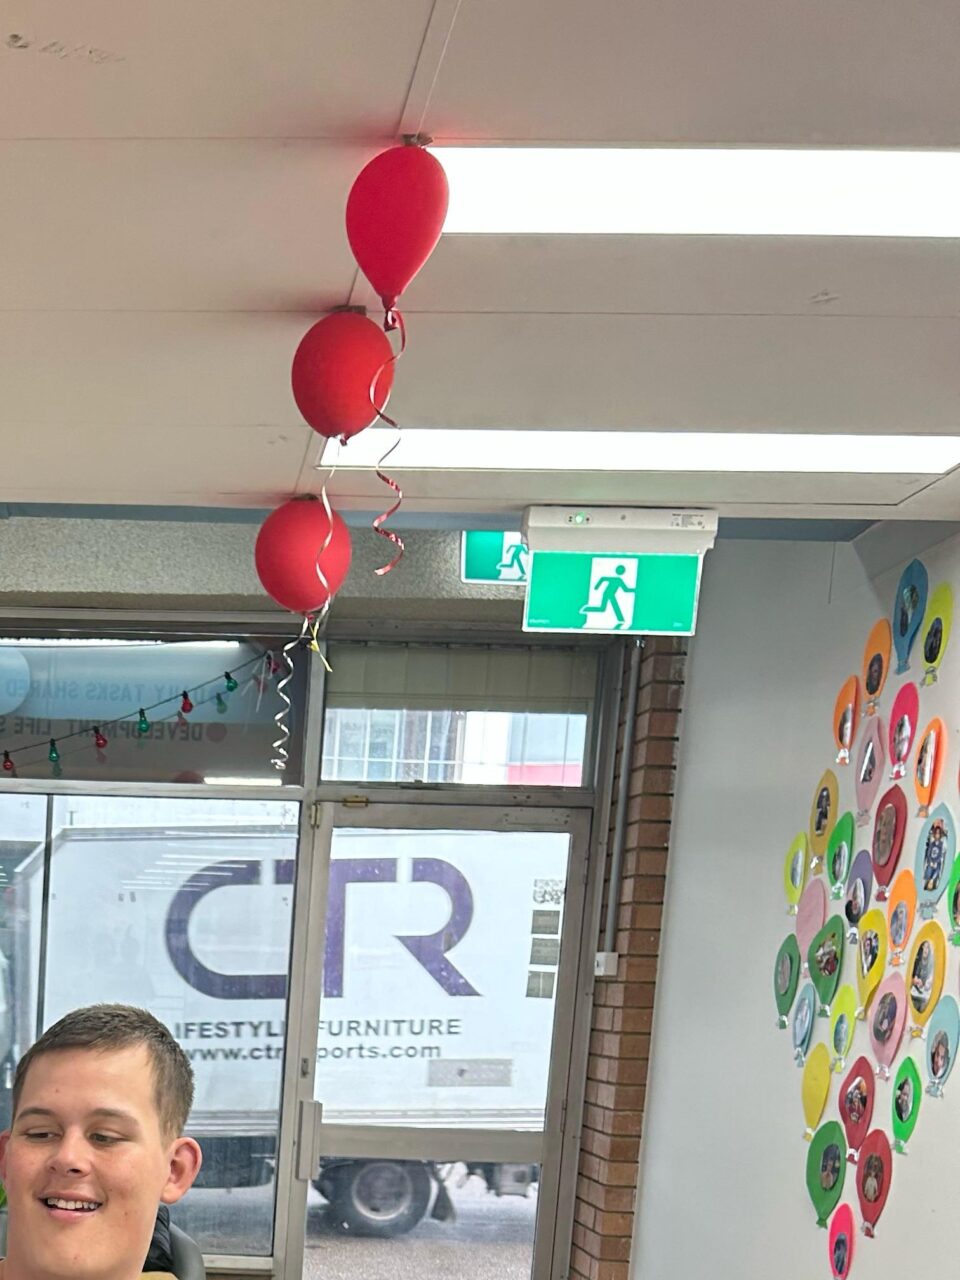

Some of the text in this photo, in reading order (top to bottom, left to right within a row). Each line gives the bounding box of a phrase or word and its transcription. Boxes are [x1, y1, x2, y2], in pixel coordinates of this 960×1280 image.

[164, 857, 483, 1000] CTR
[174, 1019, 462, 1039] IFESTYL FURNITURE
